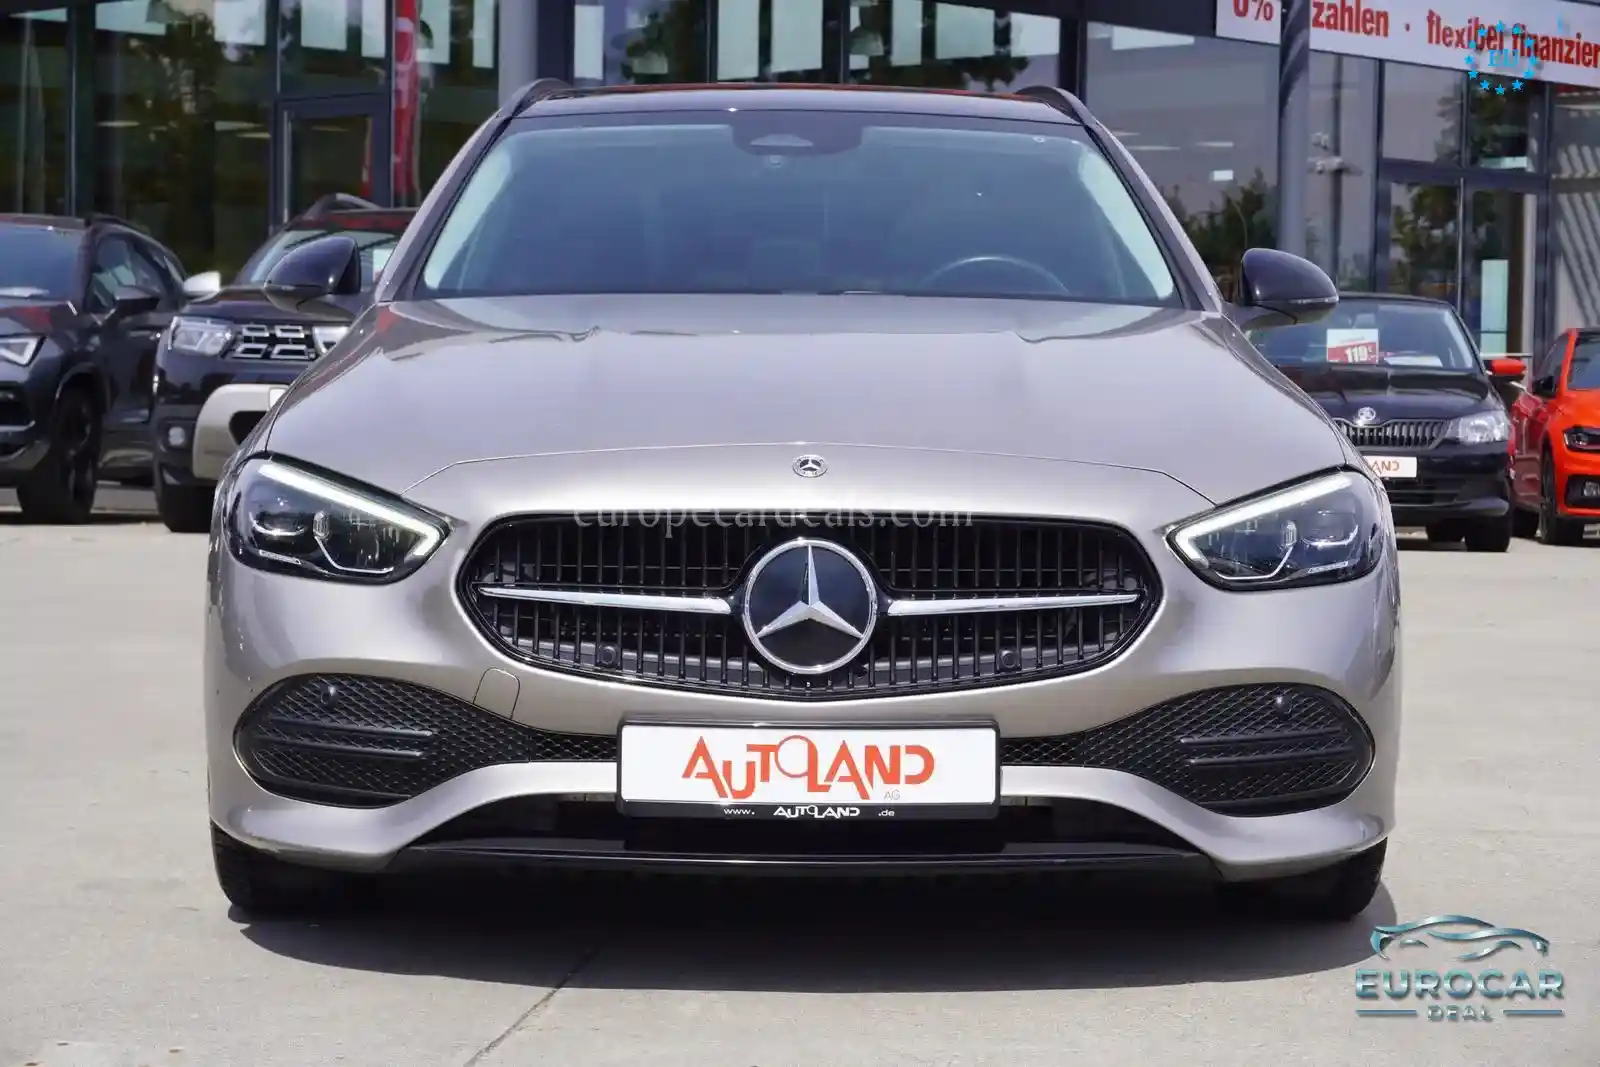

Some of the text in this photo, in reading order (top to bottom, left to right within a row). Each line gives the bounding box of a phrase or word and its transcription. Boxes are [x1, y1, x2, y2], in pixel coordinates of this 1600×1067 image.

[1312, 0, 1389, 37] zahlen
[682, 735, 935, 800] AUTOLAND
[884, 790, 901, 801] AG
[773, 804, 861, 819] AUTOLAND
